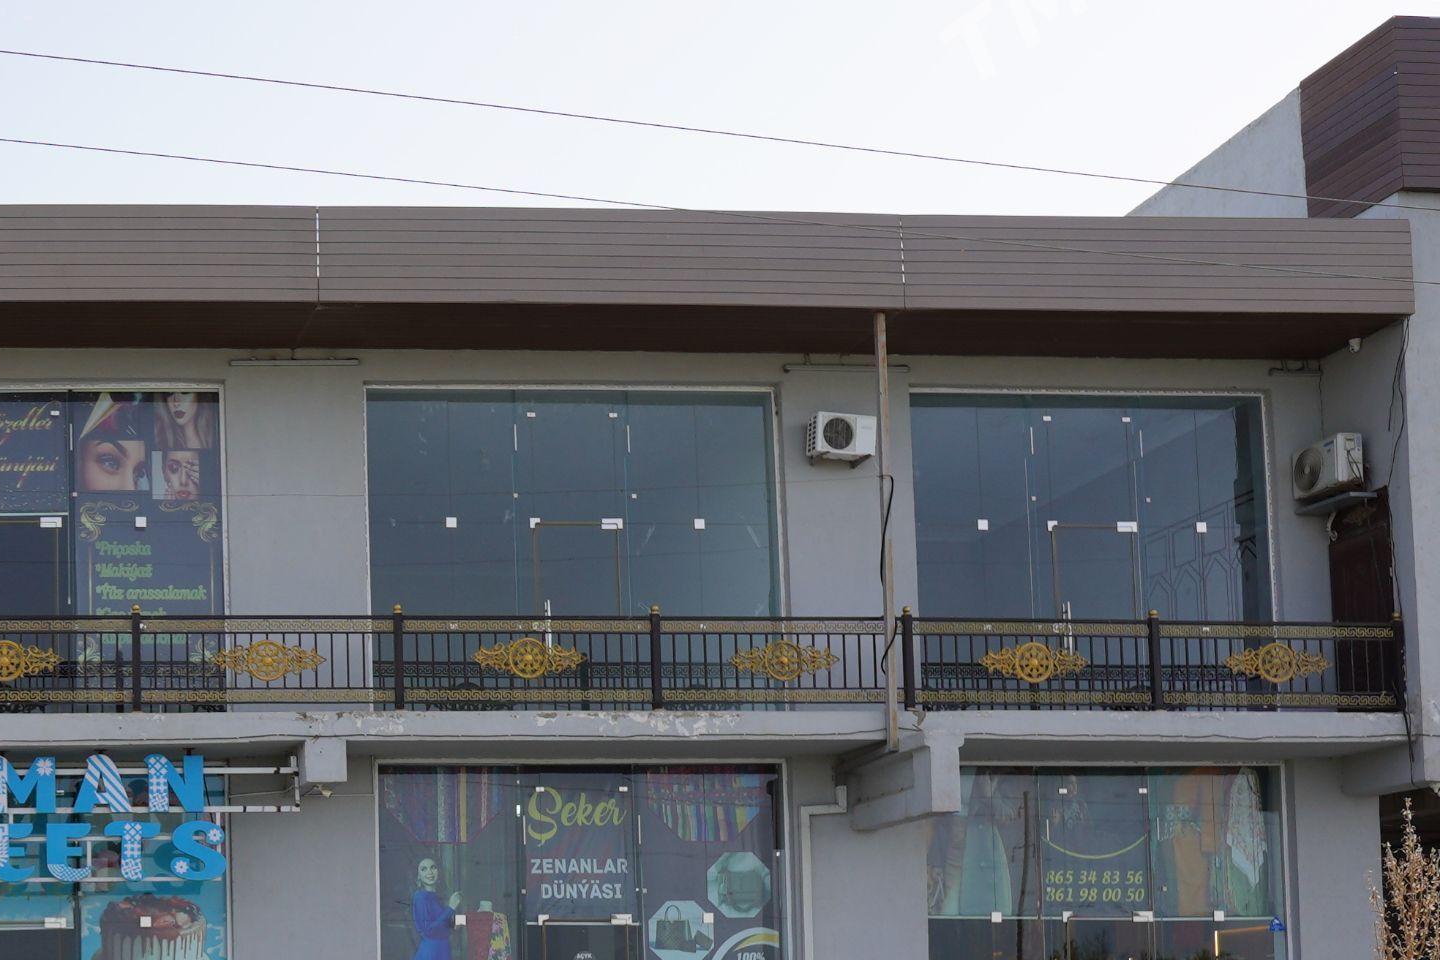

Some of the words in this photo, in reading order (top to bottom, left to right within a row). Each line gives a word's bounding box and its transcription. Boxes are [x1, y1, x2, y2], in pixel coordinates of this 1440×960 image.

[528, 786, 628, 848] Şeker
[531, 858, 629, 874] ZENANLAR
[1079, 870, 1098, 884] 34
[1102, 870, 1121, 884] 83
[1126, 870, 1143, 885] 56
[540, 879, 623, 900] DÜNÝÄSI
[1080, 887, 1098, 902] 98
[1103, 887, 1121, 902] 00
[1126, 888, 1145, 902] 50
